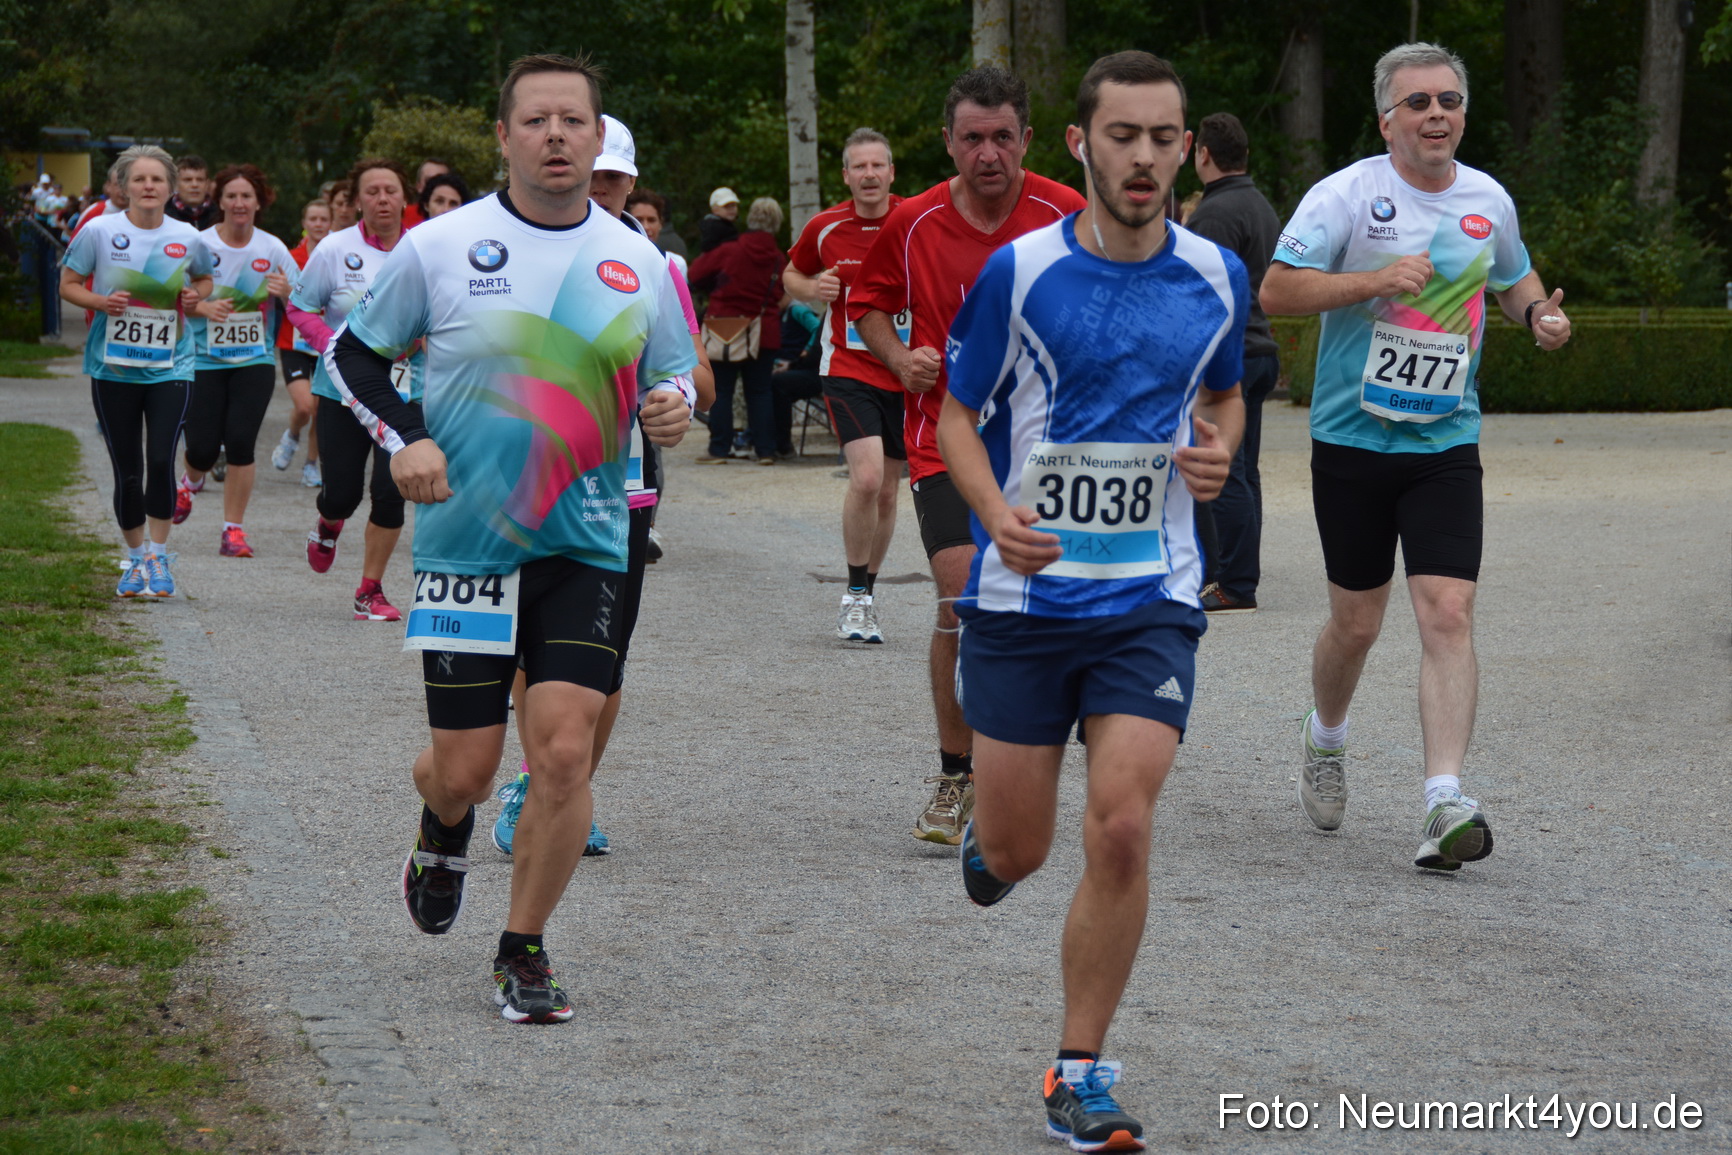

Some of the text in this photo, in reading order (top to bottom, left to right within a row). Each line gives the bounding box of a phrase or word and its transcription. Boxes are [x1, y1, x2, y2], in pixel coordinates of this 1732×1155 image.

[1368, 226, 1398, 236] PARTL
[1464, 219, 1490, 233] Hervis
[1279, 232, 1308, 256] OCK
[469, 278, 511, 289] PARTL
[603, 264, 636, 287] Hervis
[469, 288, 512, 297] Neumarkt
[113, 319, 169, 345] 2614
[214, 325, 259, 344] 2456
[1374, 331, 1454, 353] PARTL Neumarkt
[126, 348, 153, 359] Ulrike
[1375, 347, 1459, 390] 2477
[1389, 393, 1434, 411] Gerald
[1028, 454, 1147, 469] PARTL Neumarkt
[583, 476, 600, 495] 16.
[1036, 474, 1153, 526] 3038
[431, 615, 461, 634] Tilo
[1154, 688, 1184, 702] adidas
